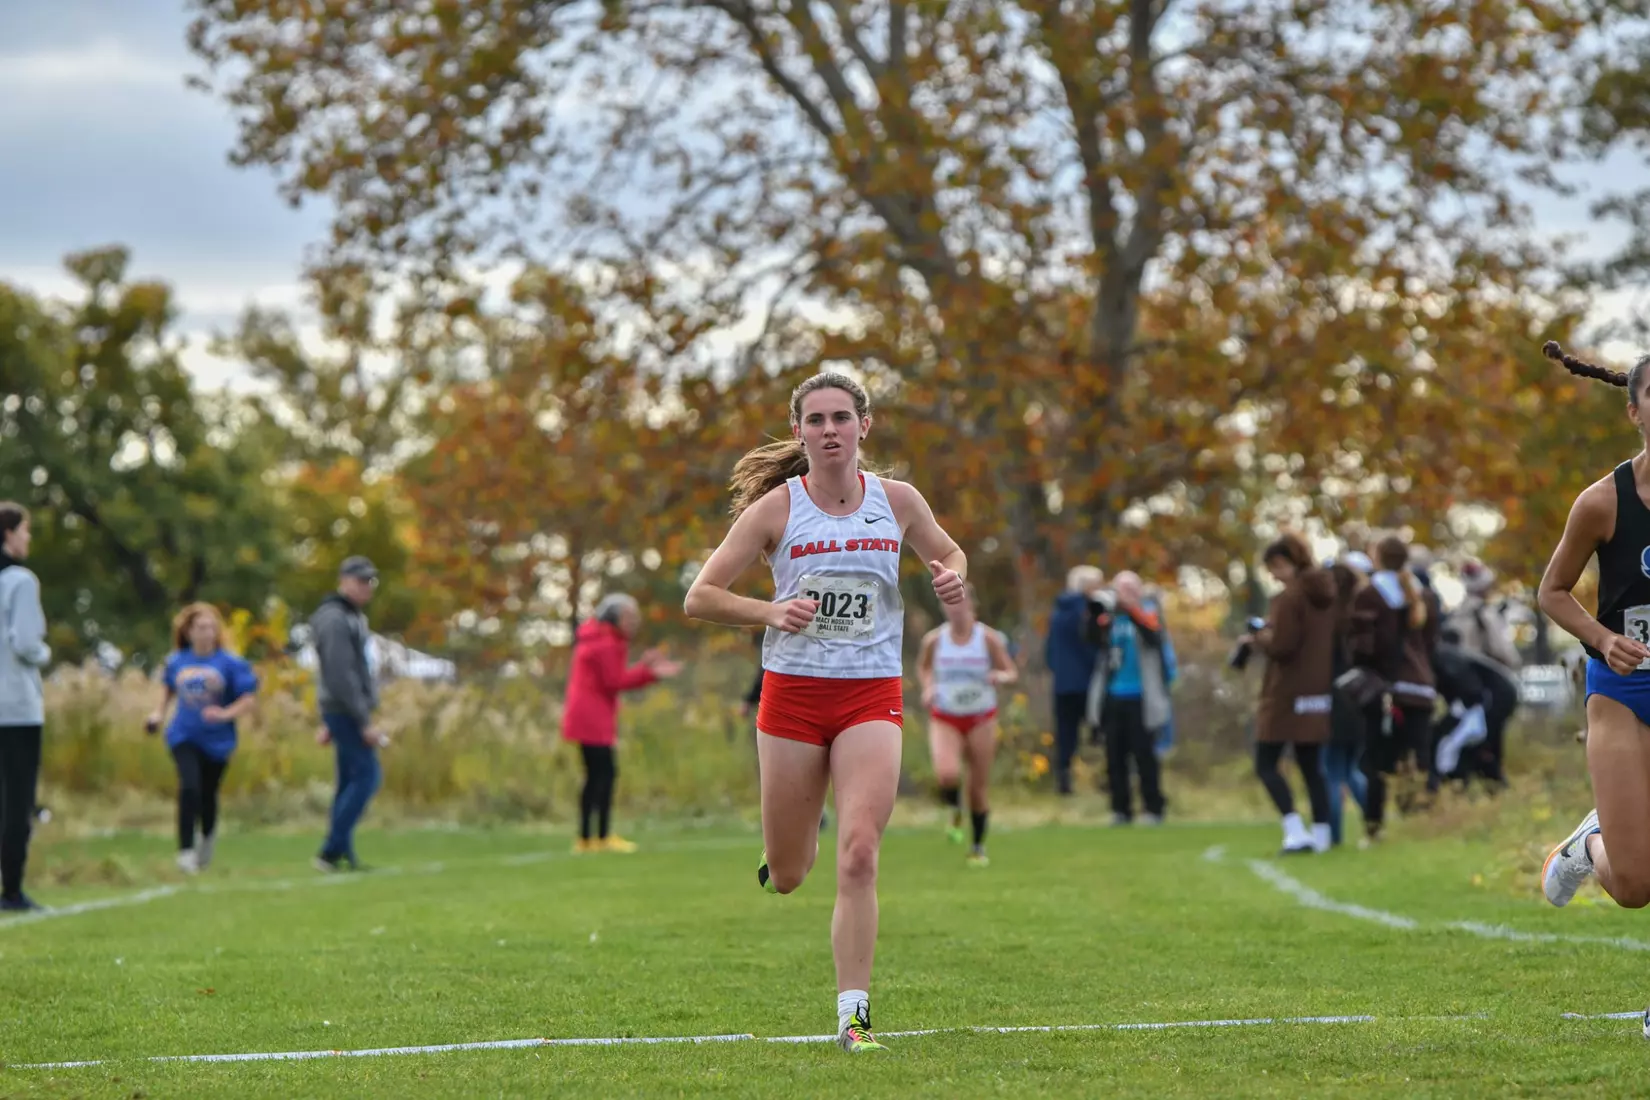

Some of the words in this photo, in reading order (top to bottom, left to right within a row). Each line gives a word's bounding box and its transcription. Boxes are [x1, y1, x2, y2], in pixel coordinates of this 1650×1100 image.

[790, 540, 842, 560] BALL
[845, 538, 899, 553] STATE
[819, 623, 832, 631] BALL
